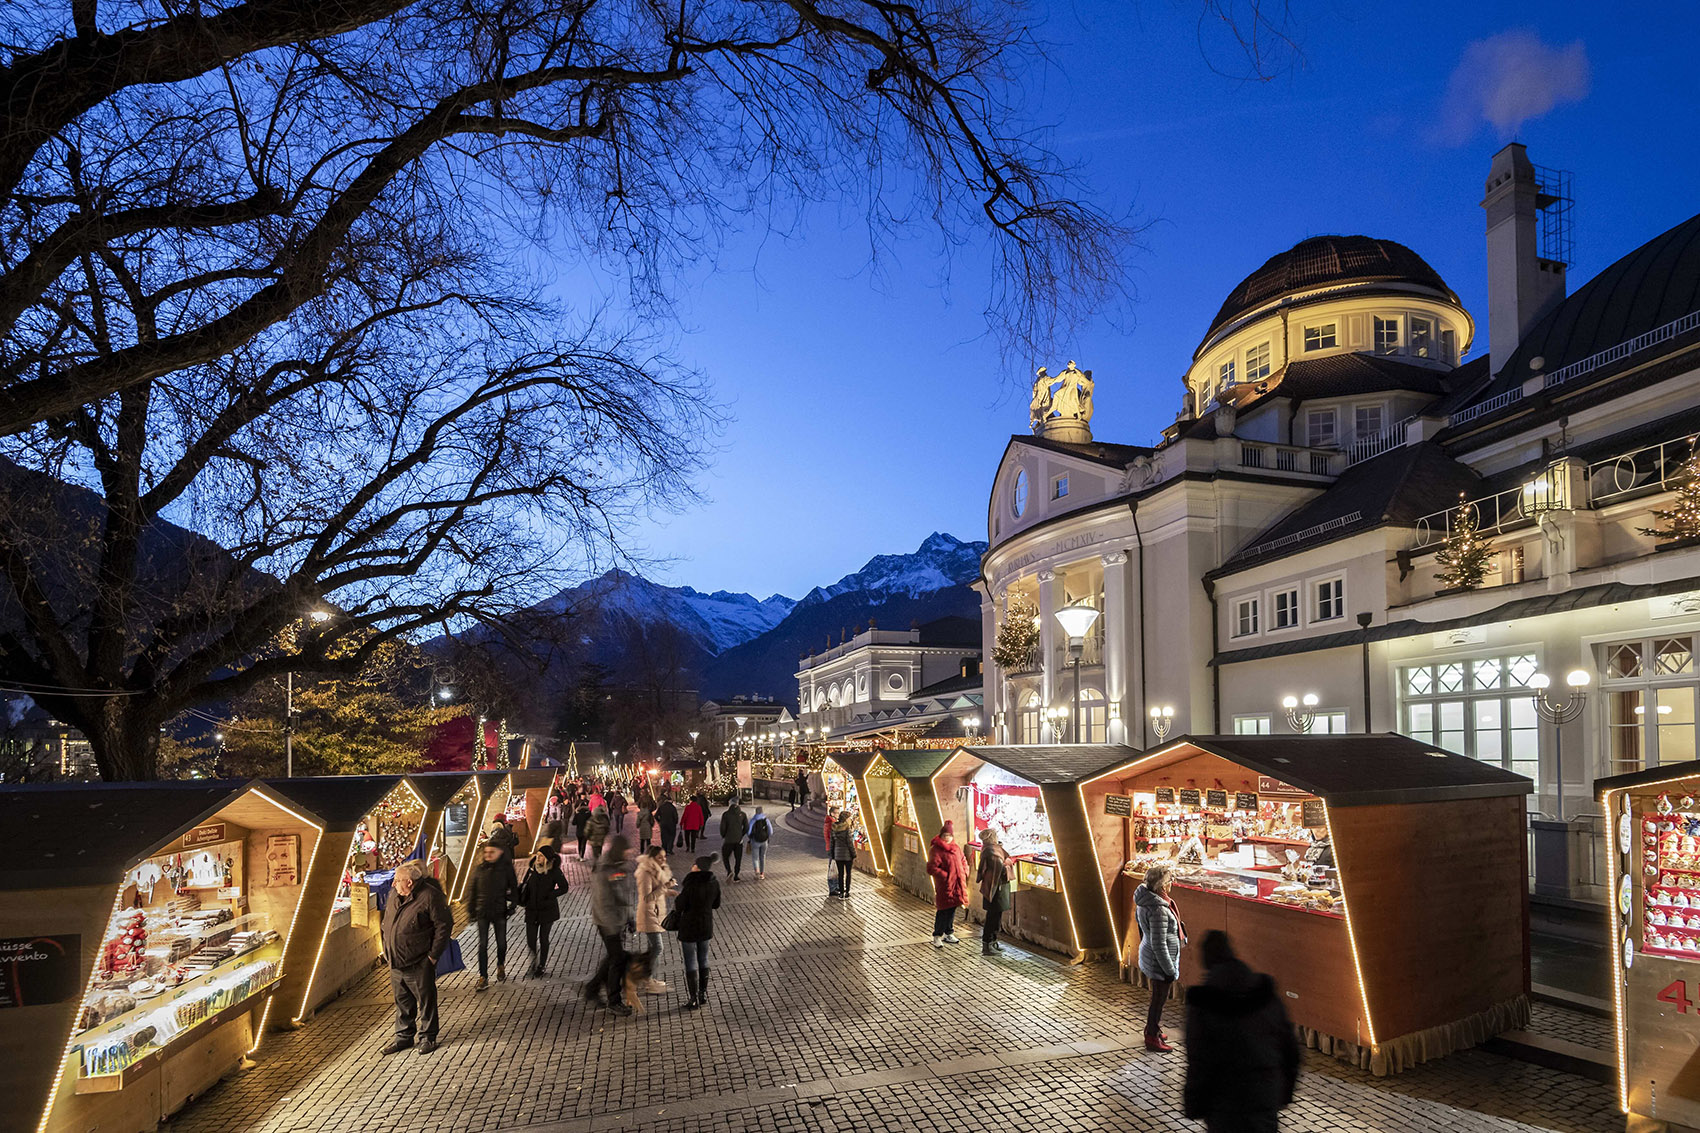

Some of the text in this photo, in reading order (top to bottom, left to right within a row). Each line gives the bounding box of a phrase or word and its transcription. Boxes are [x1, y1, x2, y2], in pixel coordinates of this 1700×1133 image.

[1260, 781, 1270, 789] 44
[185, 834, 192, 842] 43
[0, 942, 33, 951] üsse
[0, 951, 48, 963] vvento
[1656, 979, 1700, 1016] 4
